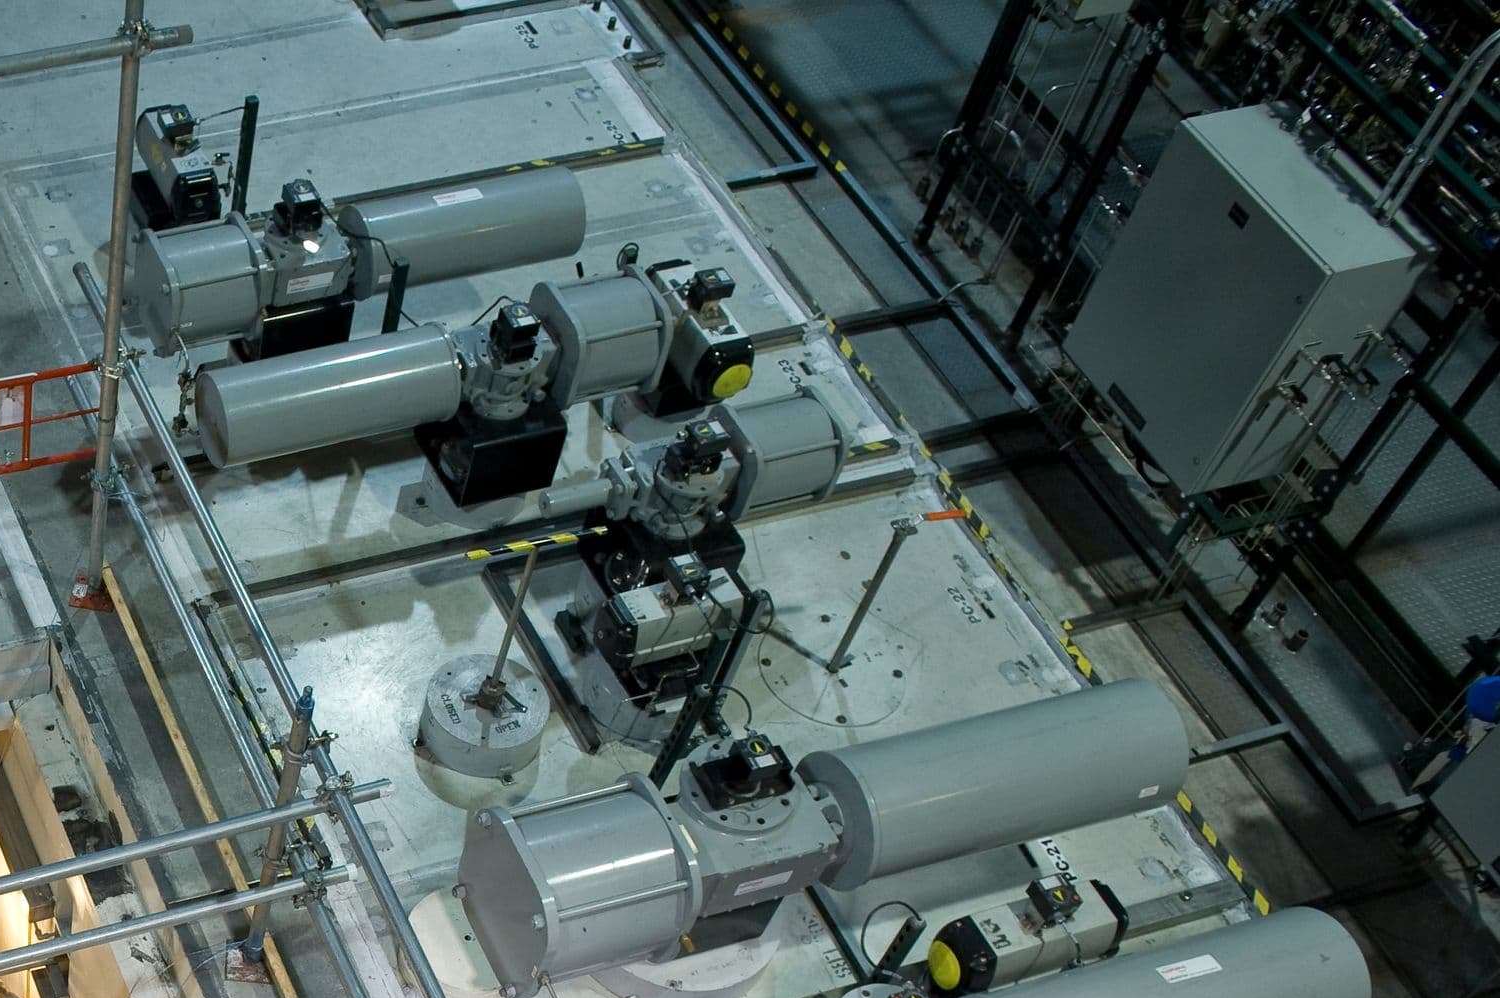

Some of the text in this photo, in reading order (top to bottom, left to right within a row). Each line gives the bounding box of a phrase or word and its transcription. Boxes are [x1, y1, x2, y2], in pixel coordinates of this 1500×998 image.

[515, 24, 539, 50] PC-25
[947, 586, 981, 624] PC-22
[440, 694, 462, 725] CLOSED
[494, 720, 521, 734] OPEN
[1041, 839, 1078, 882] PC-21
